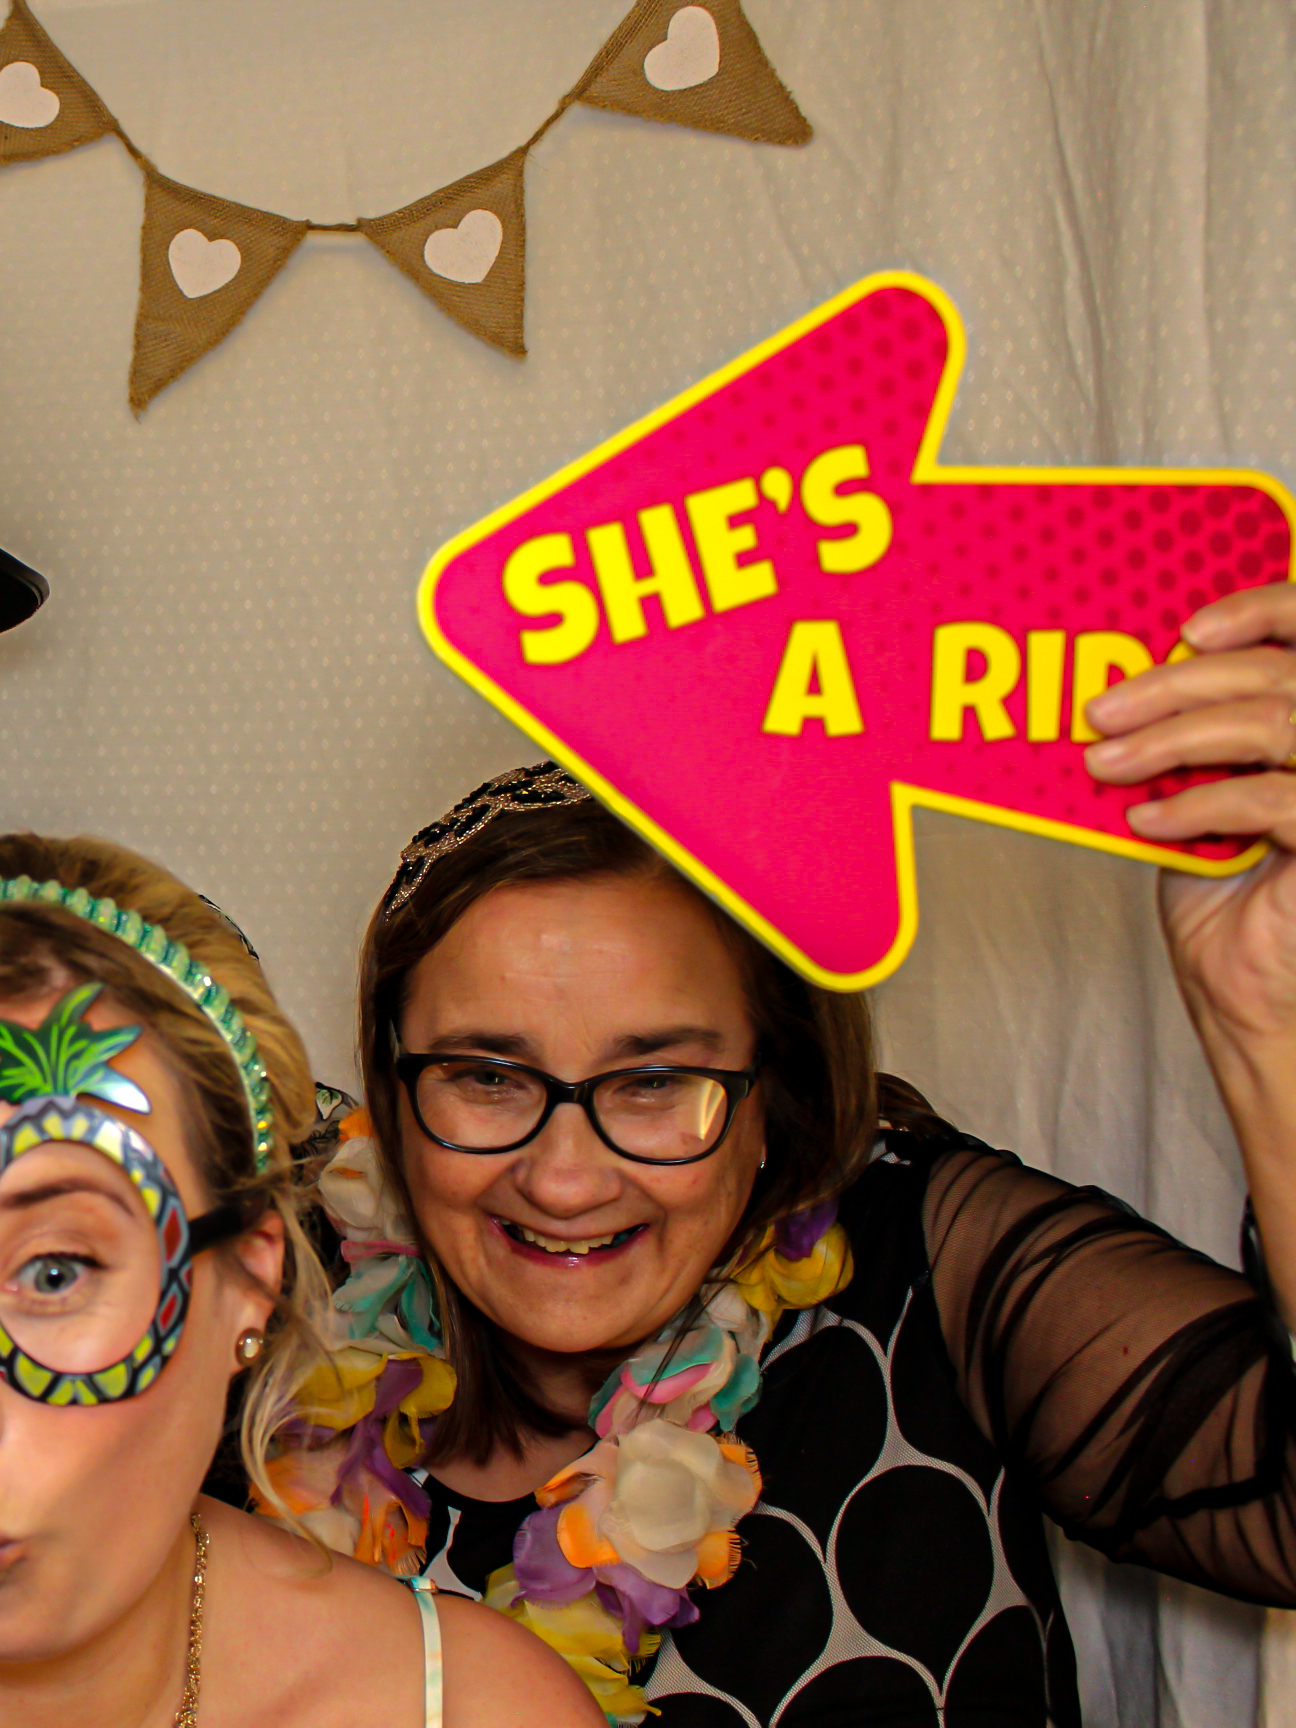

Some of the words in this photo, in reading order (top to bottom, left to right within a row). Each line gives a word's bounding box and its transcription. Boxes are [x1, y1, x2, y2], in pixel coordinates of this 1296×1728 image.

[502, 444, 894, 665] SHE’S
[762, 620, 864, 737] A
[929, 620, 1194, 743] RID
